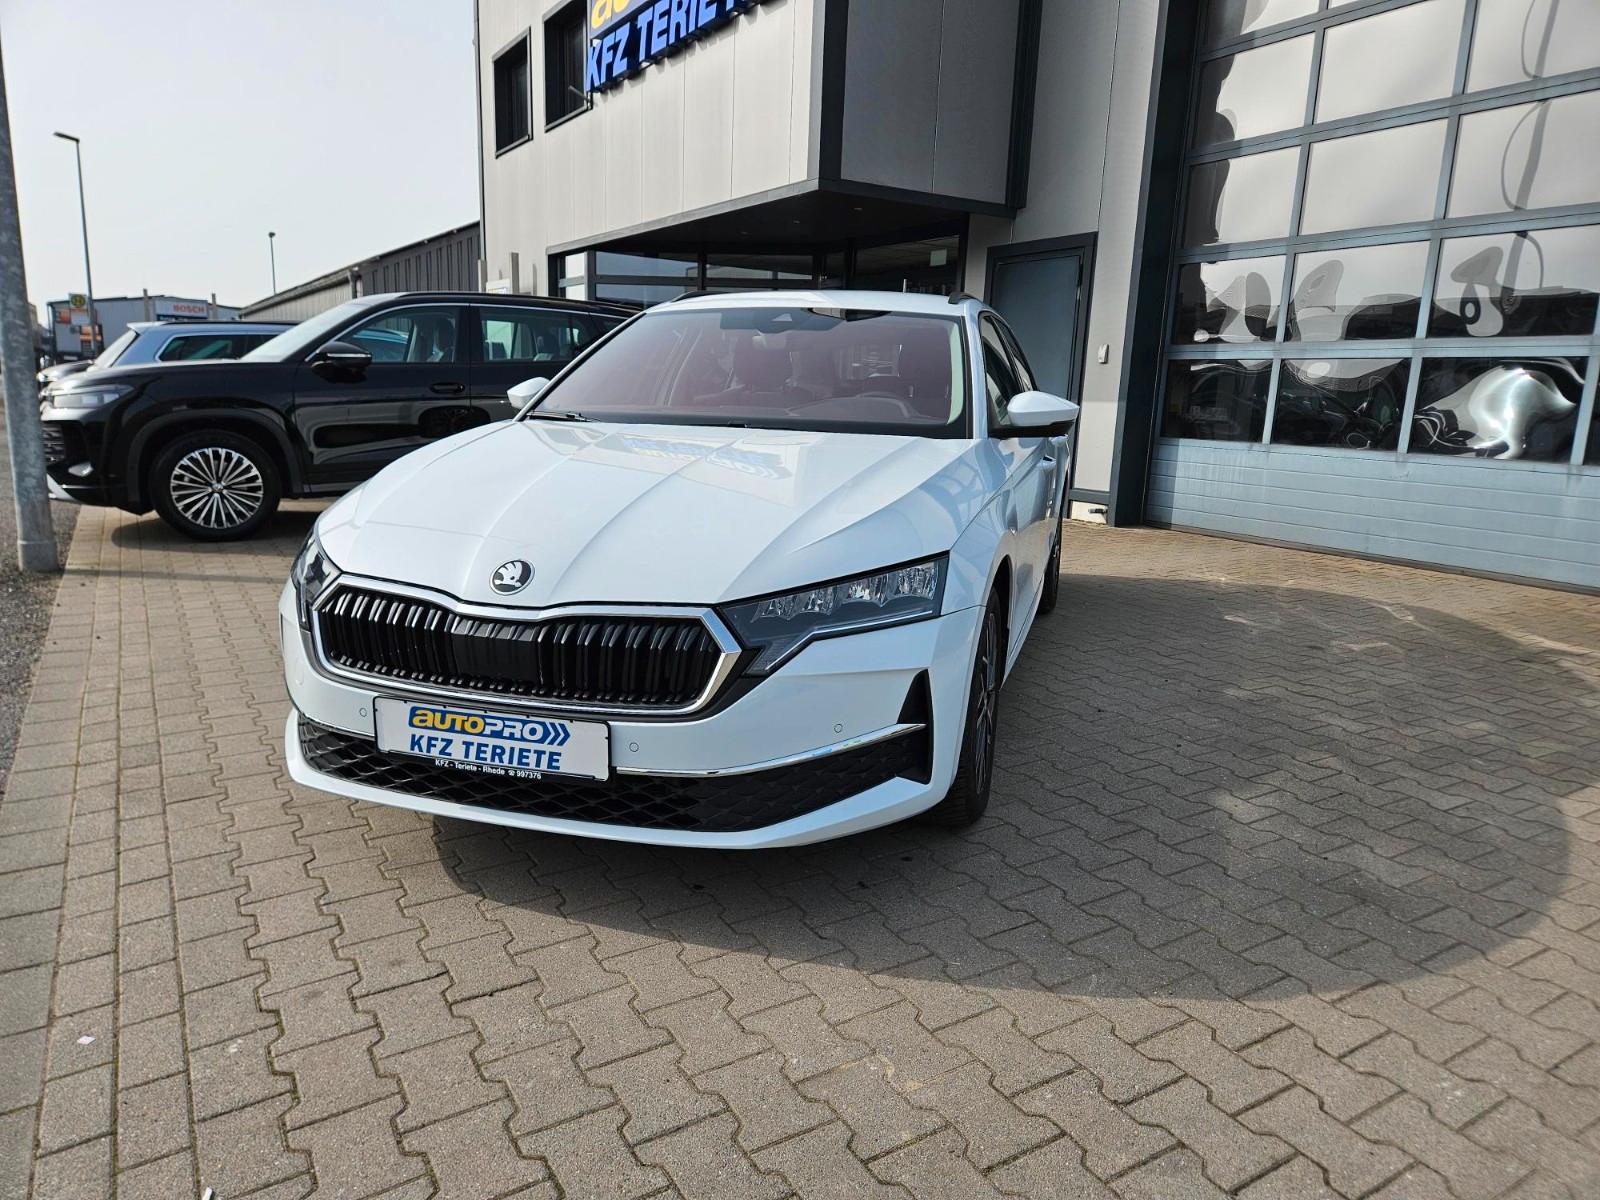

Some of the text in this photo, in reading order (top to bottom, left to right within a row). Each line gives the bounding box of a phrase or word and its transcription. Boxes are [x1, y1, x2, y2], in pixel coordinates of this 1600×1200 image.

[586, 22, 630, 92] KFZ
[173, 304, 206, 314] BOSCH
[410, 734, 562, 771] KFZ TERIETE
[435, 759, 449, 767] KFZ
[455, 762, 477, 771] Teriete
[483, 766, 505, 775] Rhede
